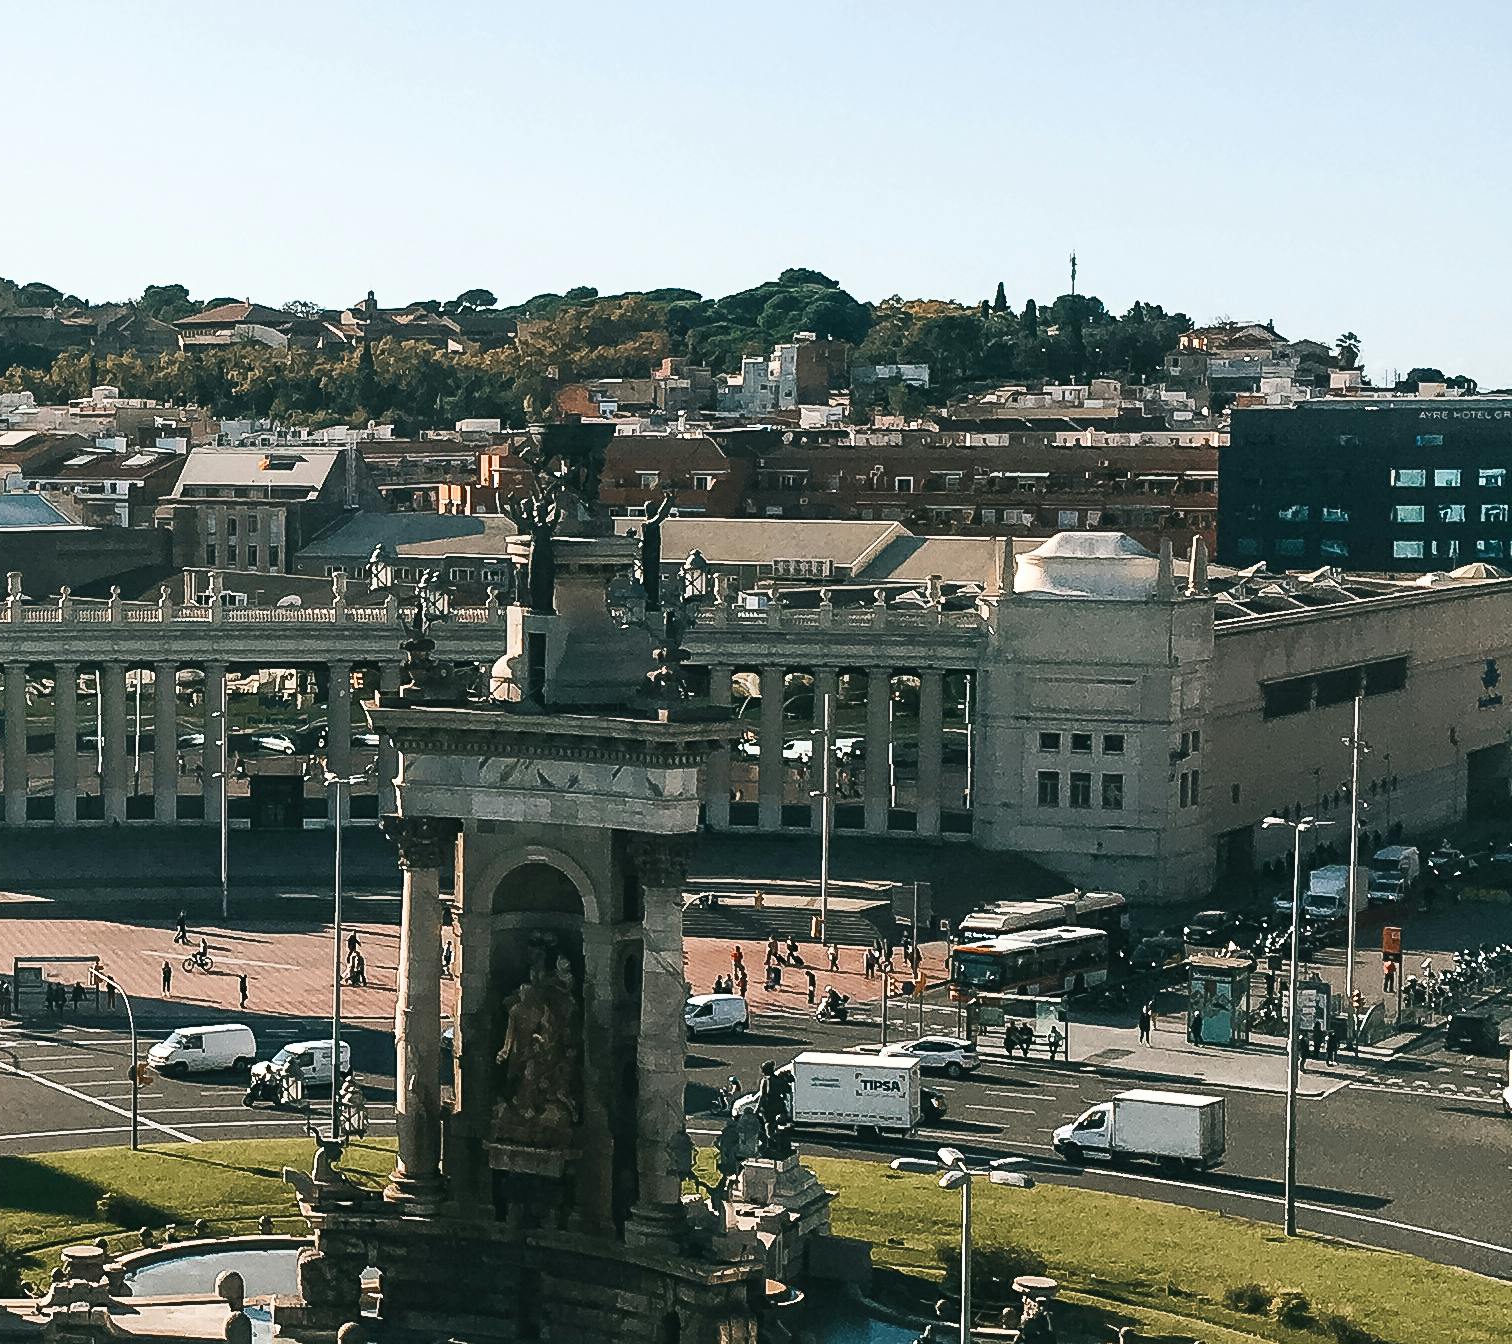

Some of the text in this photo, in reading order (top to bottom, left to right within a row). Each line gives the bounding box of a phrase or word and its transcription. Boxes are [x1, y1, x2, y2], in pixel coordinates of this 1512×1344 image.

[1419, 410, 1449, 420] AYRE
[1453, 410, 1492, 420] HOTEL
[860, 1079, 902, 1093] TIPSA
